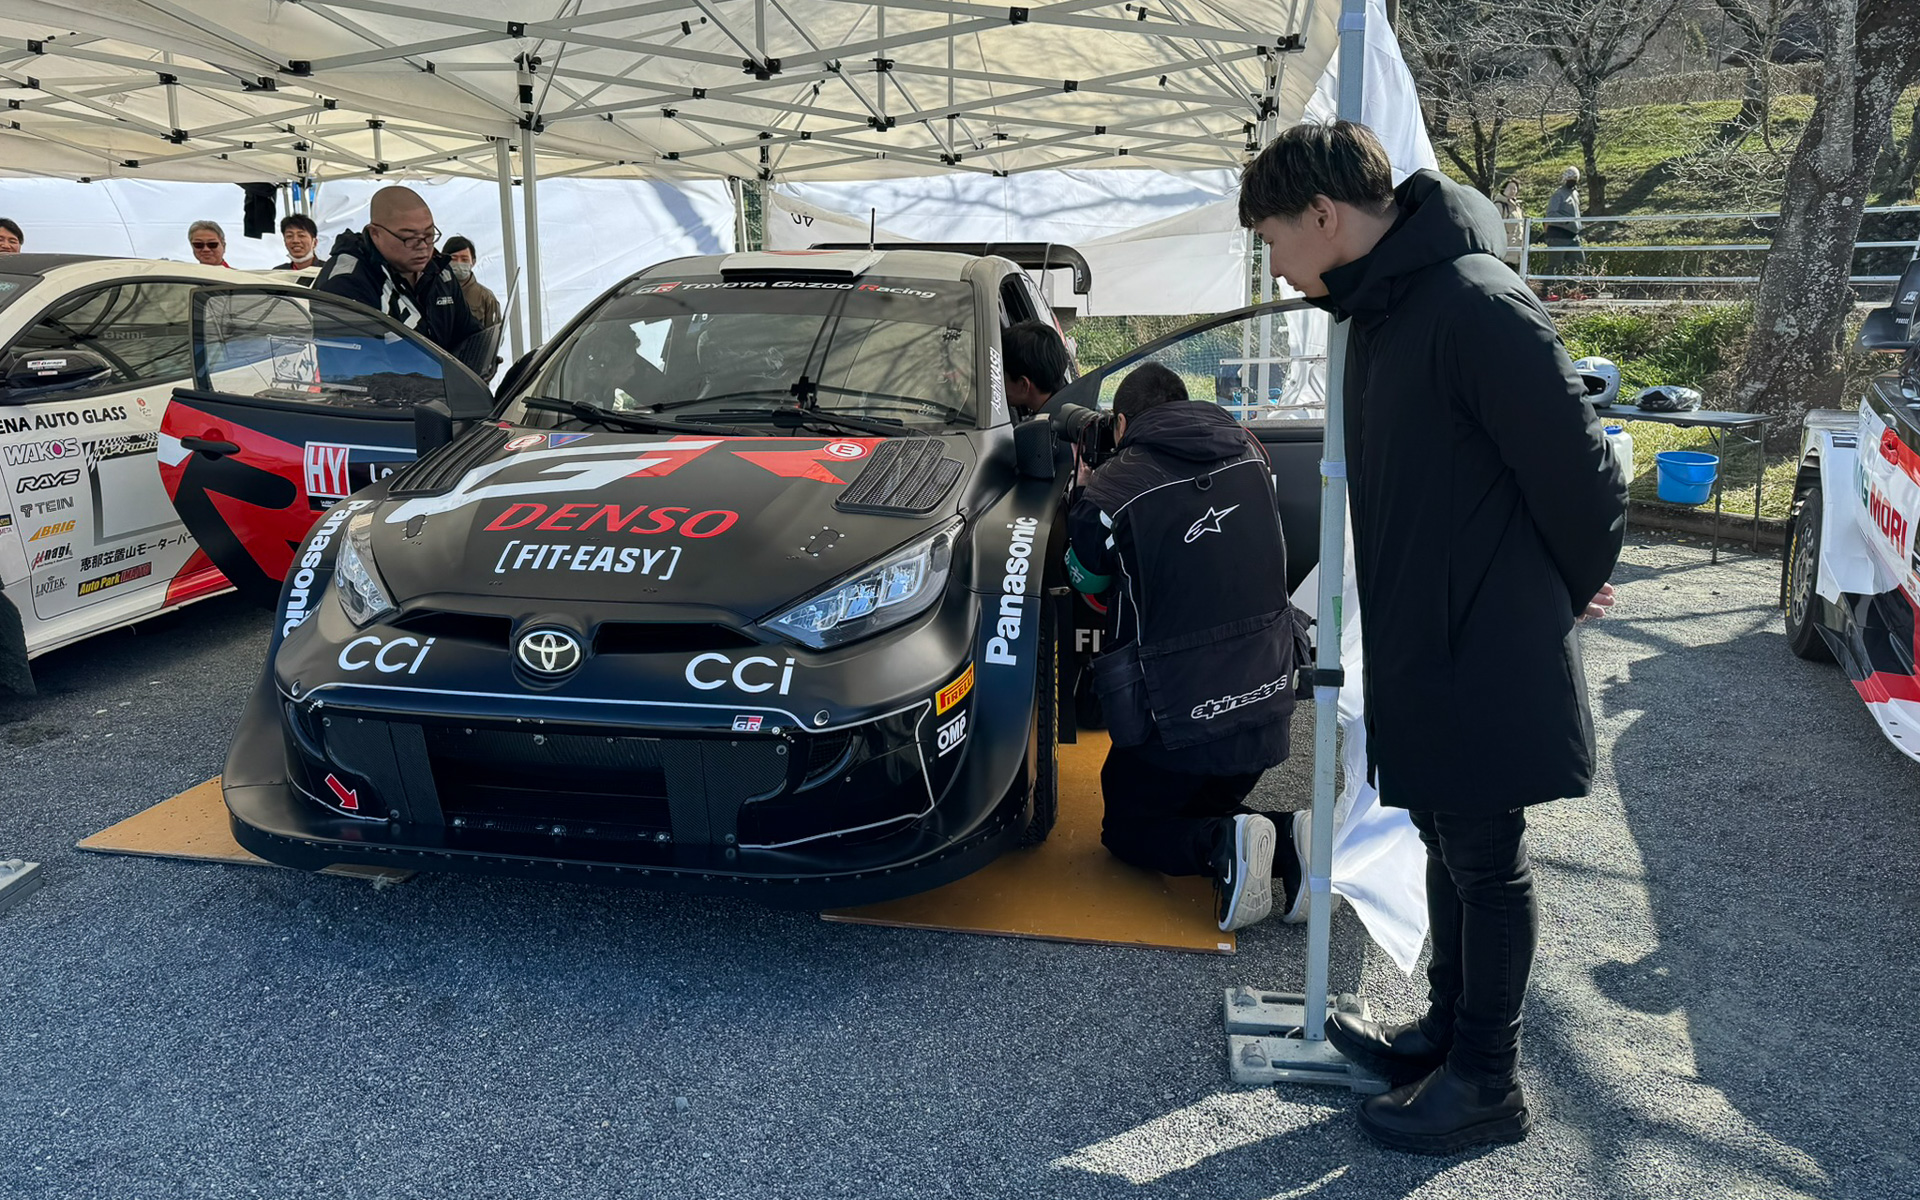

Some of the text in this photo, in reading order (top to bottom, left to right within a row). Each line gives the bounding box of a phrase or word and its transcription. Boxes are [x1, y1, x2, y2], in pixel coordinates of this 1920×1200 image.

[682, 281, 767, 291] TOYOTA
[771, 280, 855, 291] GAZOO
[858, 284, 937, 299] Racing
[35, 411, 80, 430] AUTO
[82, 405, 128, 425] GLASS
[3, 437, 81, 467] WAKO'S
[16, 469, 80, 494] RAYS
[308, 446, 345, 494] HY
[35, 496, 75, 515] TEIN
[483, 503, 739, 538] DENSO
[41, 520, 77, 537] BRIG
[1870, 481, 1908, 561] MORI
[283, 500, 373, 638] Panasonic
[36, 577, 66, 595] LIQTEK
[79, 582, 100, 595] Auto
[100, 574, 120, 589] Park
[985, 516, 1039, 666] Panasonic
[1075, 628, 1105, 653] FI
[940, 666, 973, 710] PIRELLI
[1190, 674, 1288, 720] alpinestars
[937, 715, 966, 750] OMP
